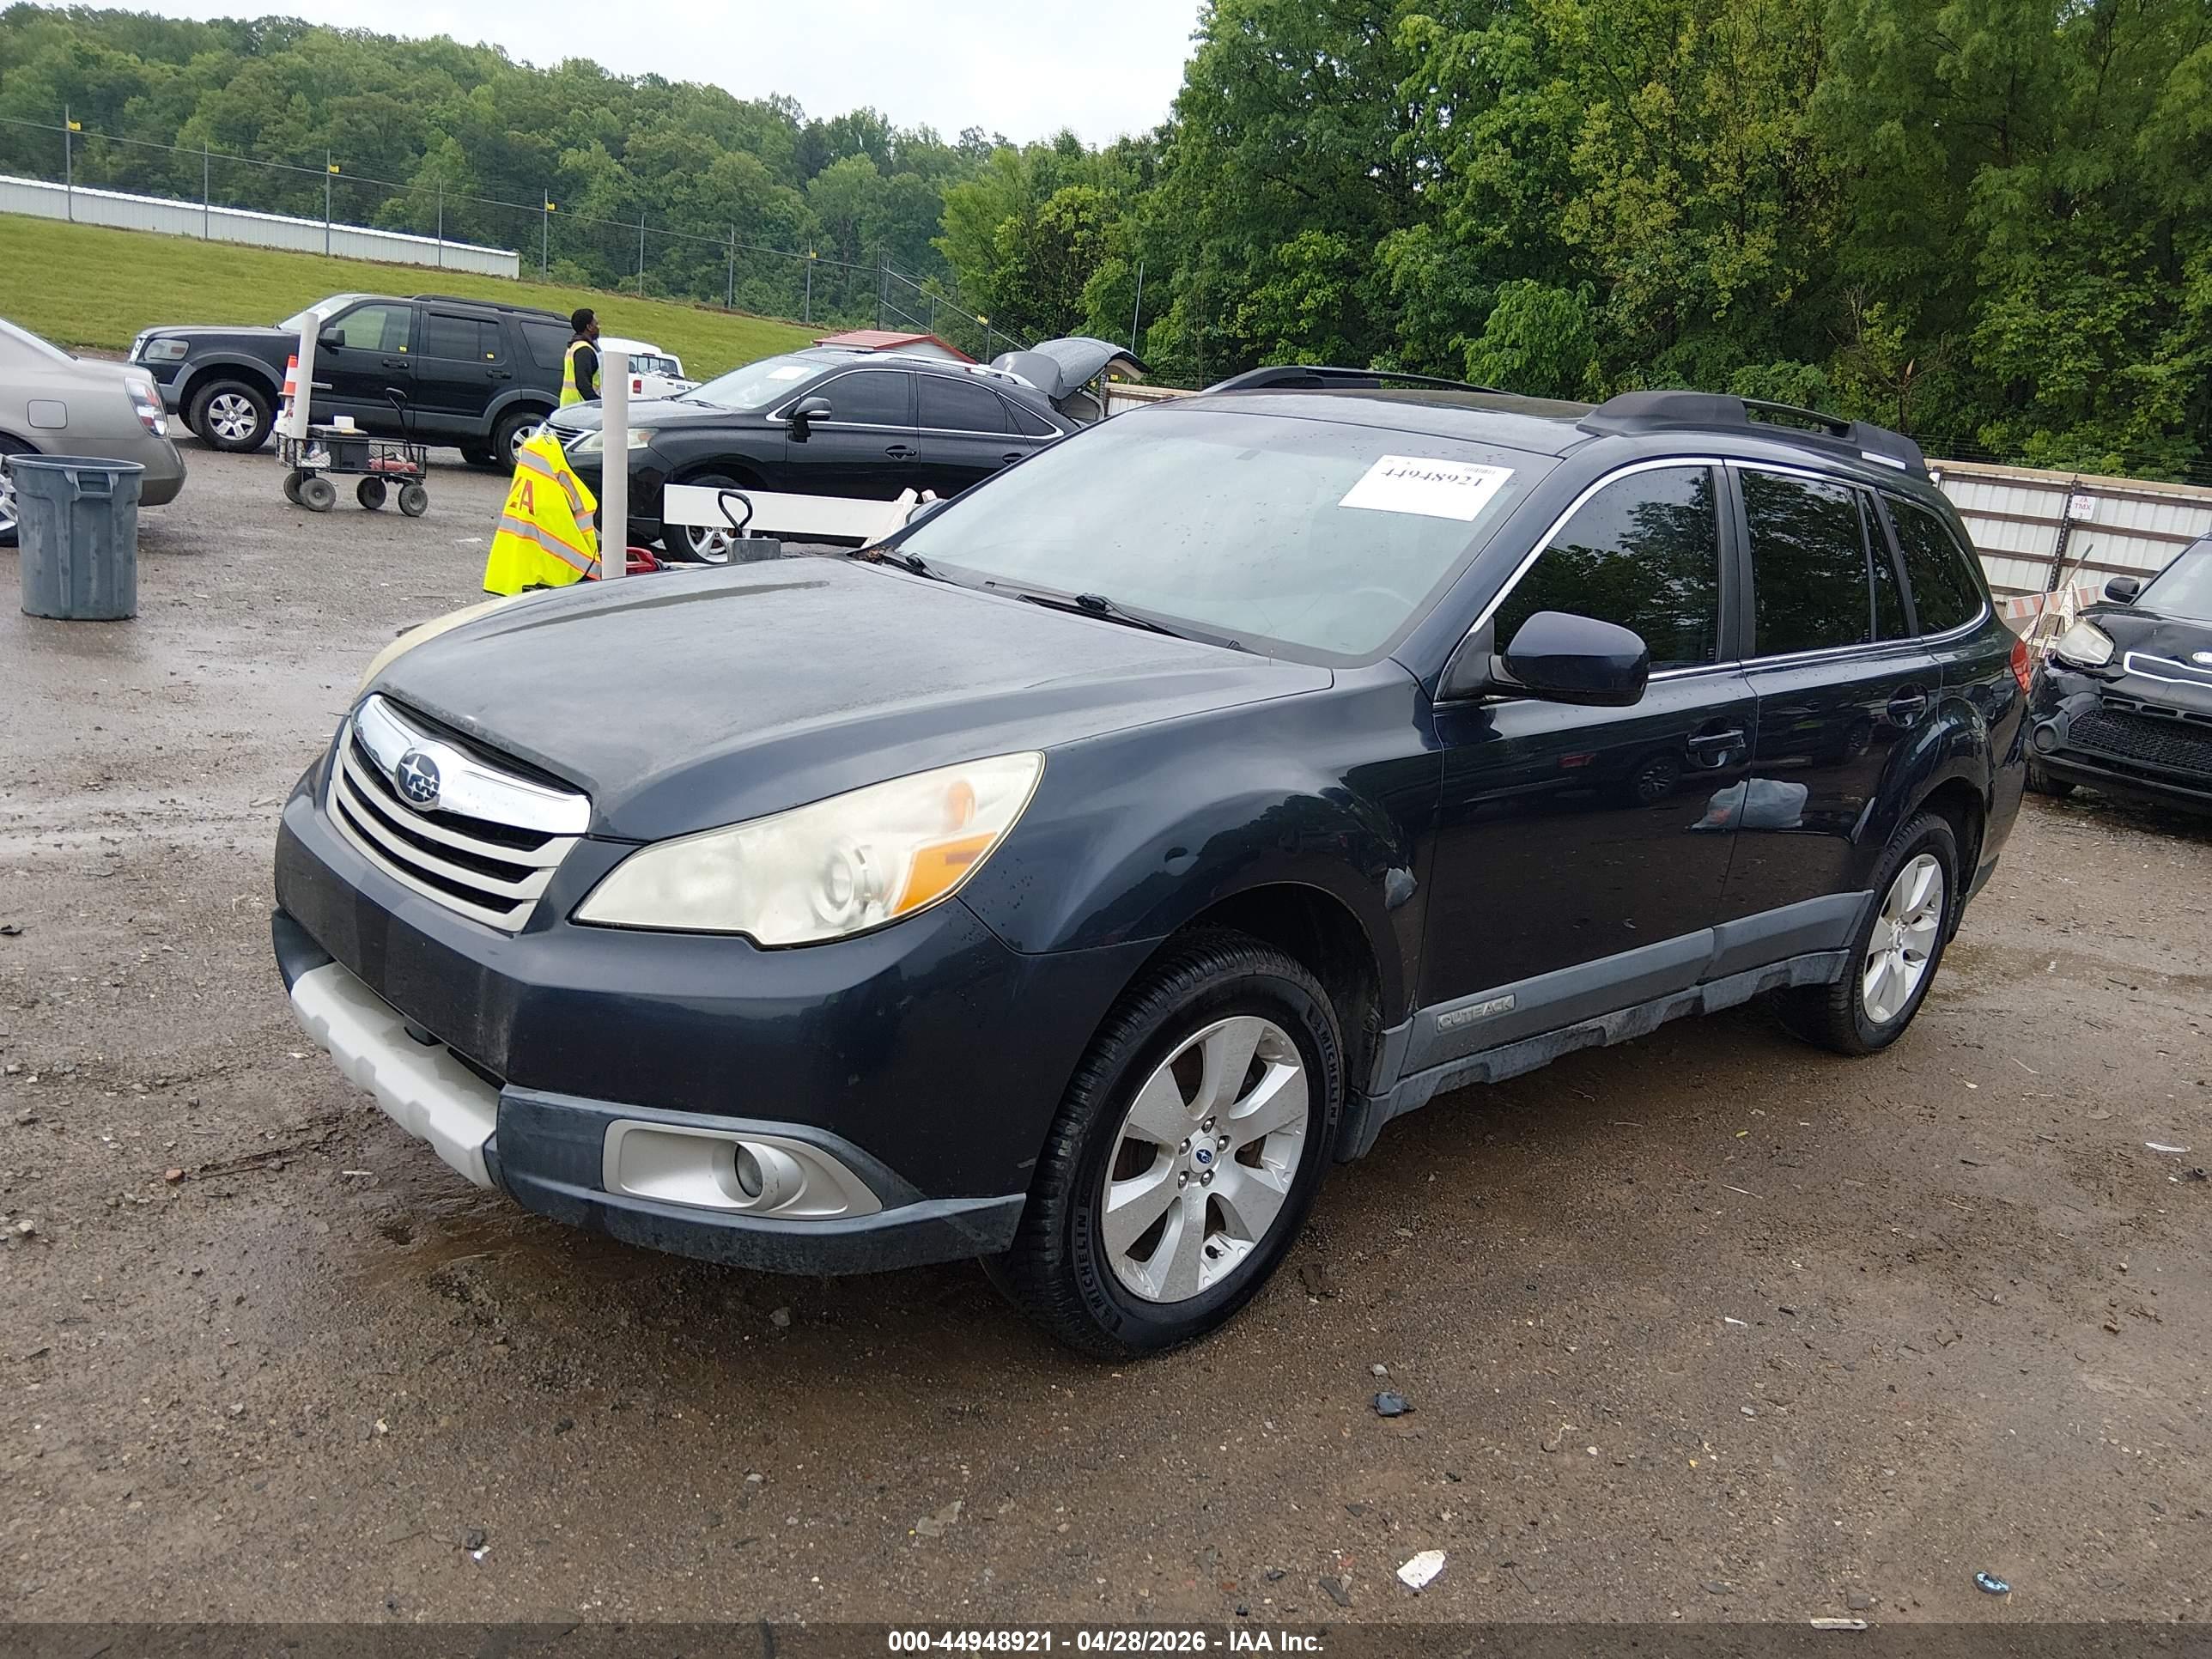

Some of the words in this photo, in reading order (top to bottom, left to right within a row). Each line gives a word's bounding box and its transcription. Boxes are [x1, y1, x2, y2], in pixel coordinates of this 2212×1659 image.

[1380, 466, 1484, 487] 44948921
[1320, 1030, 1340, 1119] MICHELIN
[1077, 1214, 1104, 1310] MICHELIN
